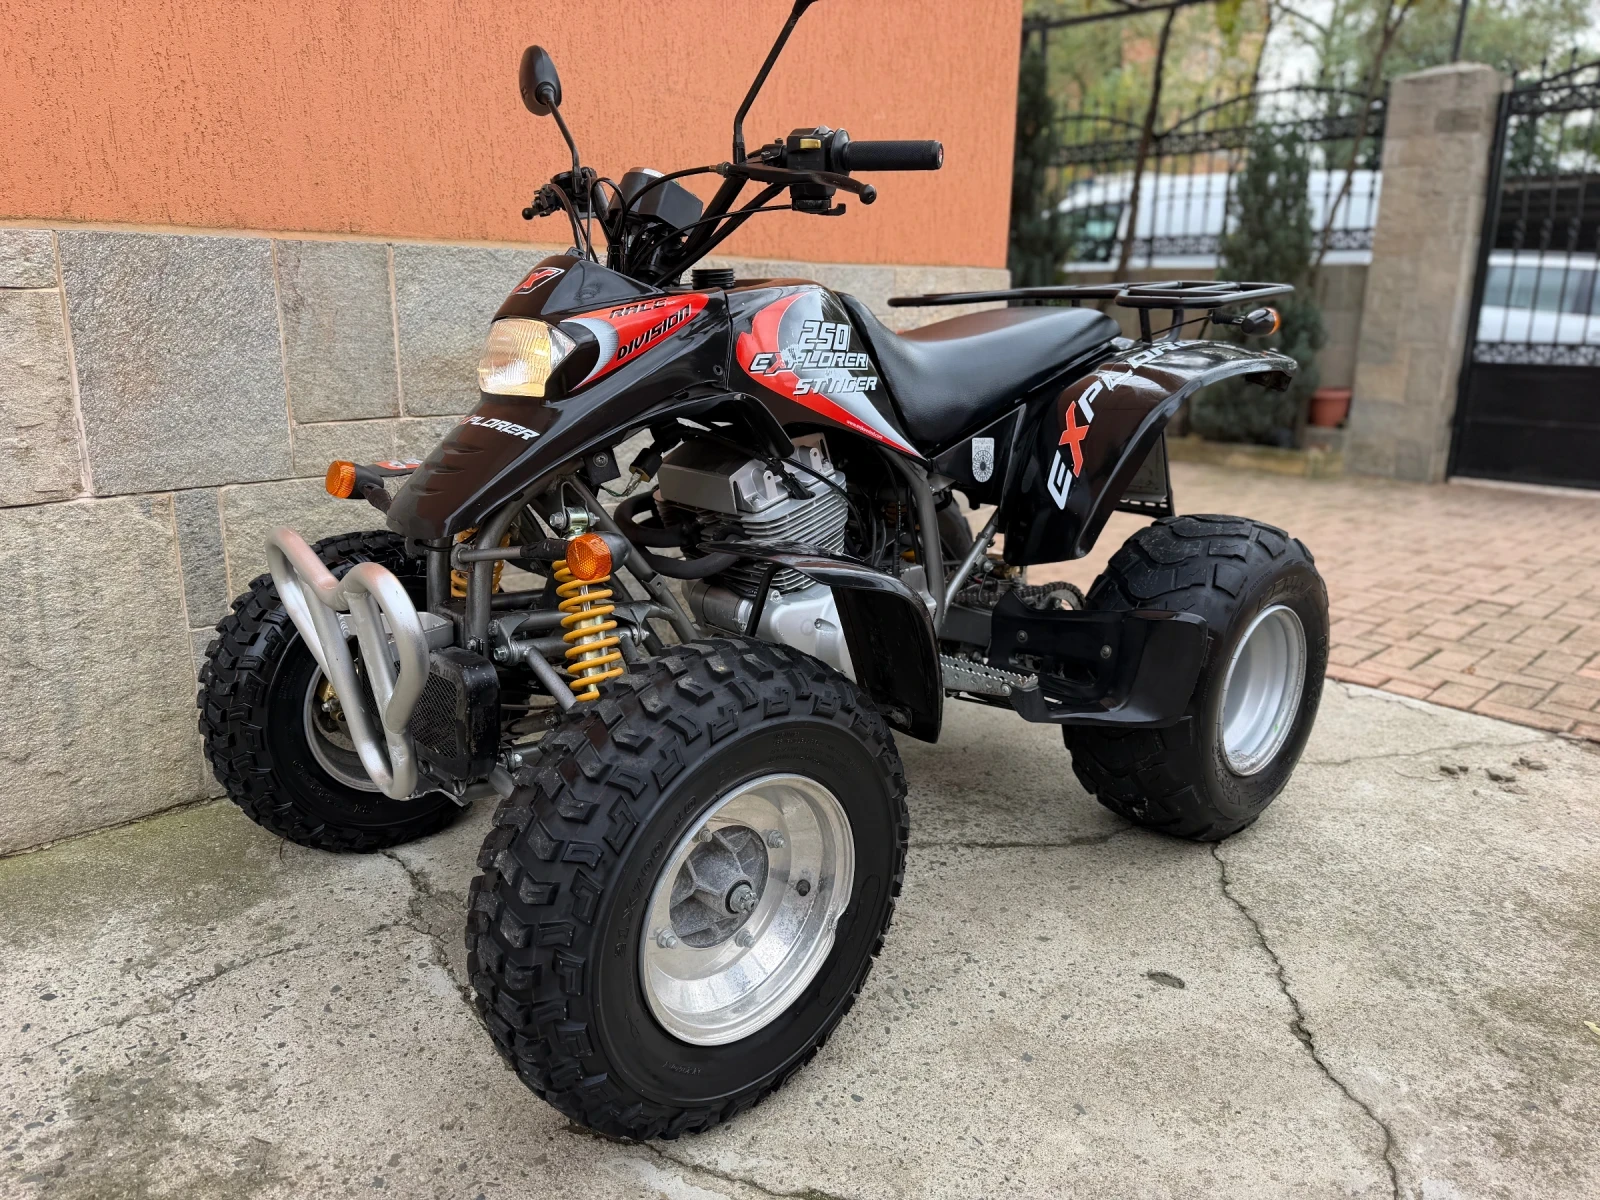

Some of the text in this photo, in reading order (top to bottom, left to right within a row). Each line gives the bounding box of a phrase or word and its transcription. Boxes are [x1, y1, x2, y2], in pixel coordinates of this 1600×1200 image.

[609, 298, 669, 319] RACE
[616, 303, 692, 361] DIVISION
[799, 320, 850, 351] 250
[749, 351, 869, 376] EXPLORER
